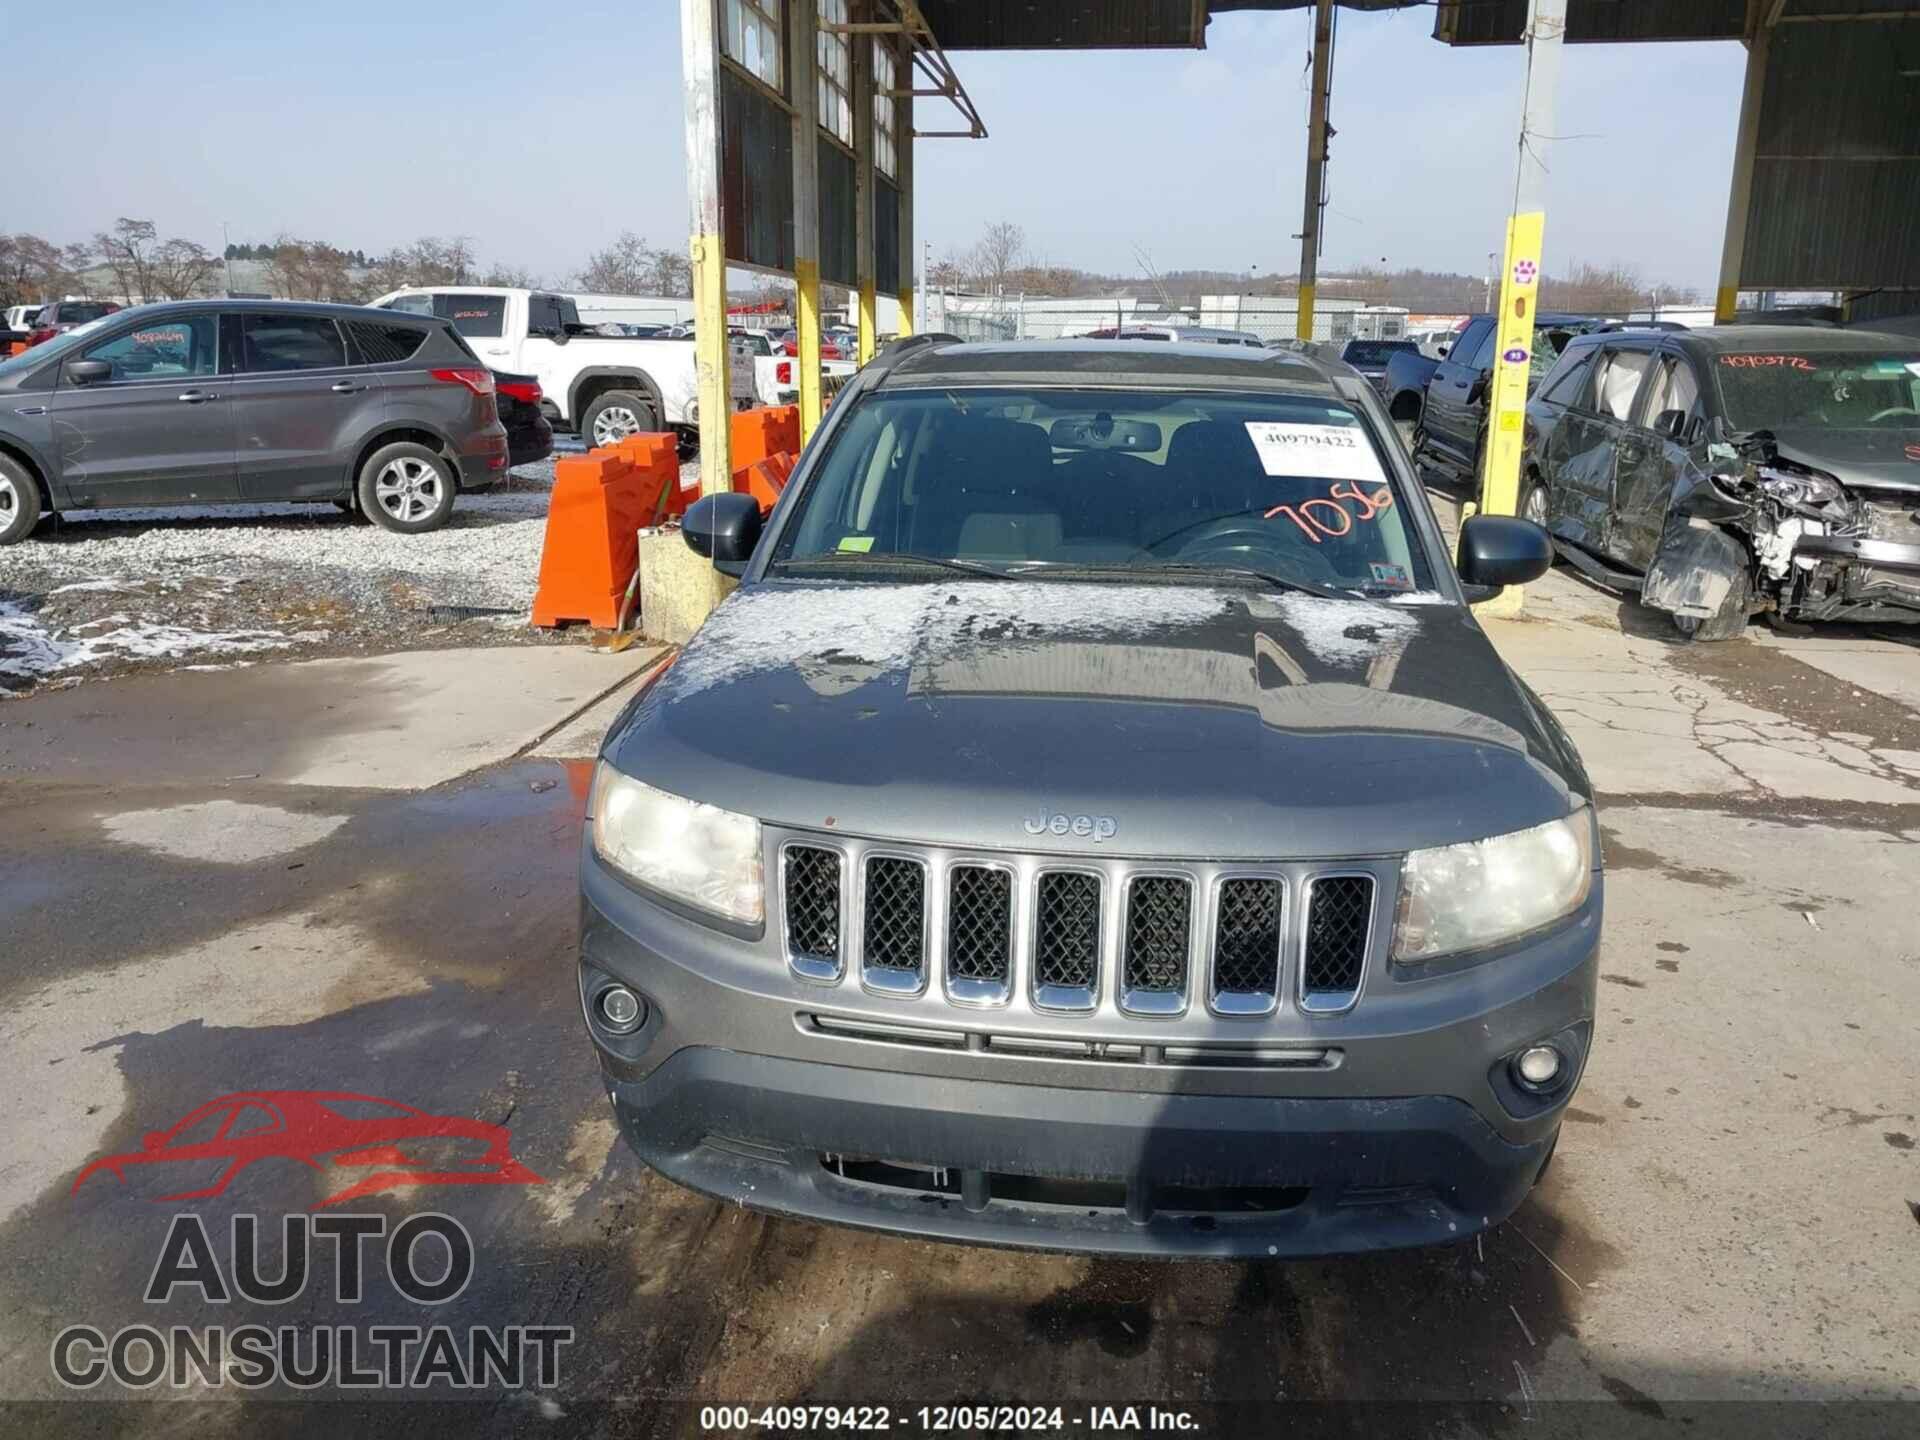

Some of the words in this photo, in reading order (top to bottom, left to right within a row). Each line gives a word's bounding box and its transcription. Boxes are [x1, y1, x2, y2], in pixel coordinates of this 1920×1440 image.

[1265, 433, 1356, 449] 40979422
[1264, 480, 1392, 543] 7056
[1024, 807, 1117, 843] Jeep
